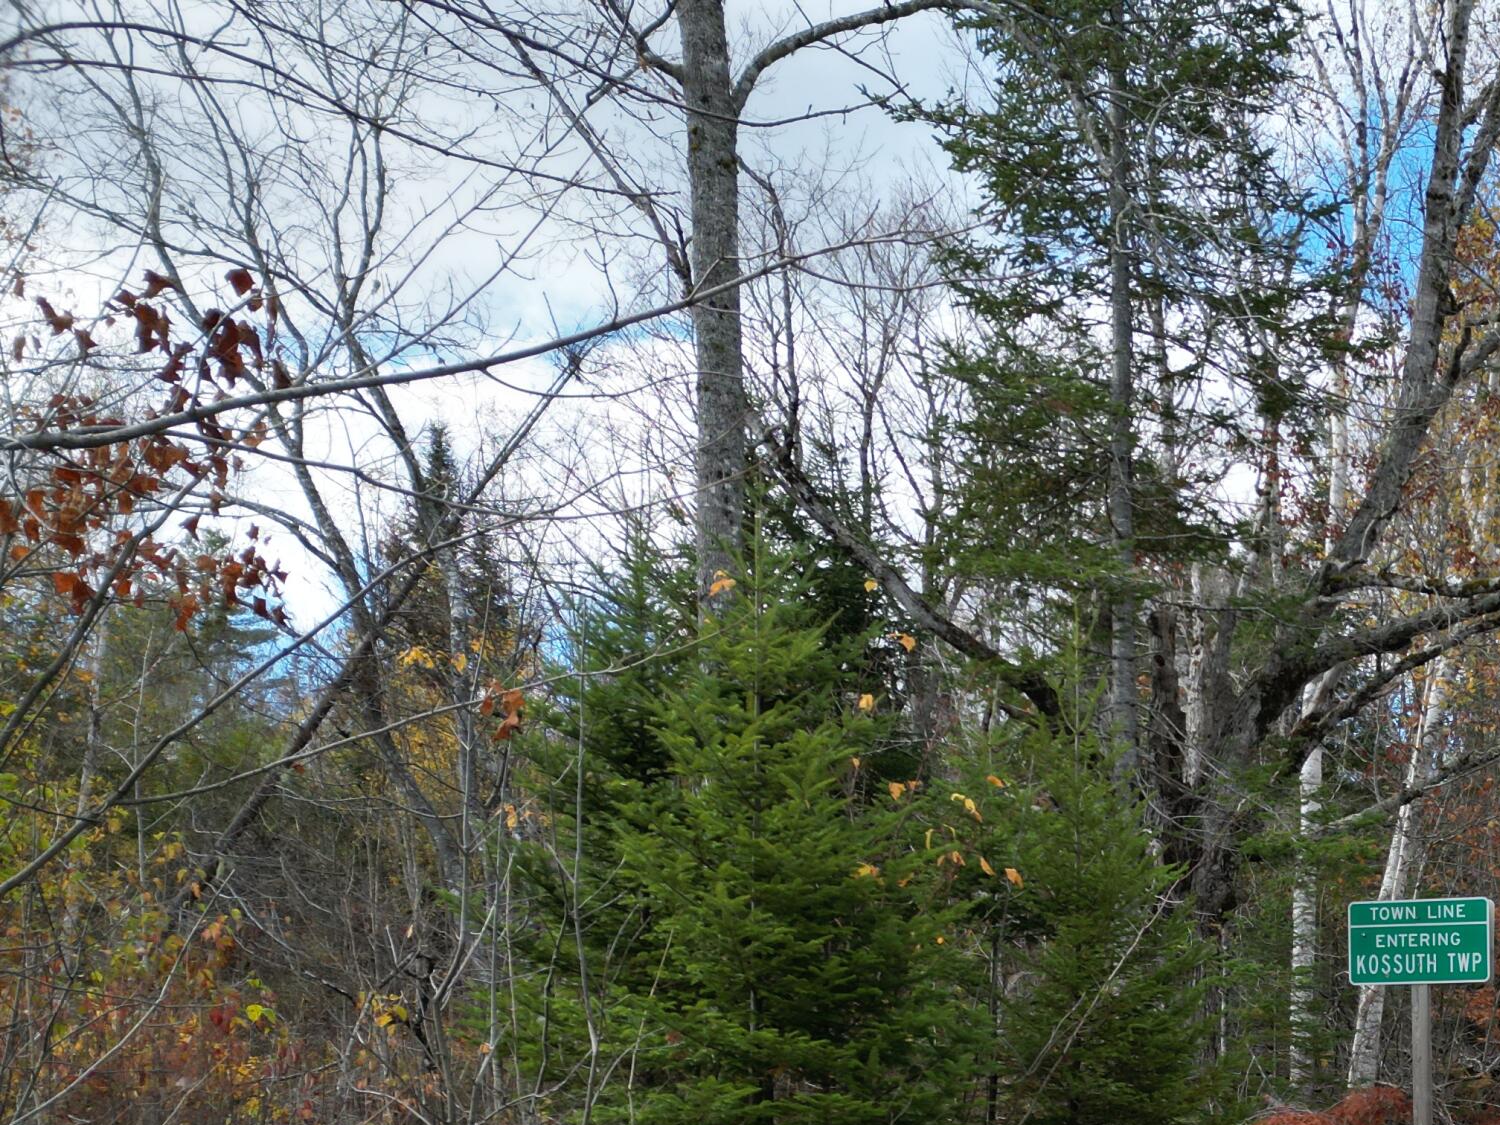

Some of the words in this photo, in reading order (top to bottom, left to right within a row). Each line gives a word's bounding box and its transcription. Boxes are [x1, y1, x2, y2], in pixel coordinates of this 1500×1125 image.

[1370, 906, 1416, 920] TOWN
[1427, 904, 1466, 918] LINE
[1375, 932, 1461, 948] ENTERING
[1356, 953, 1437, 975] KOSSUTH
[1447, 952, 1482, 973] TWP
